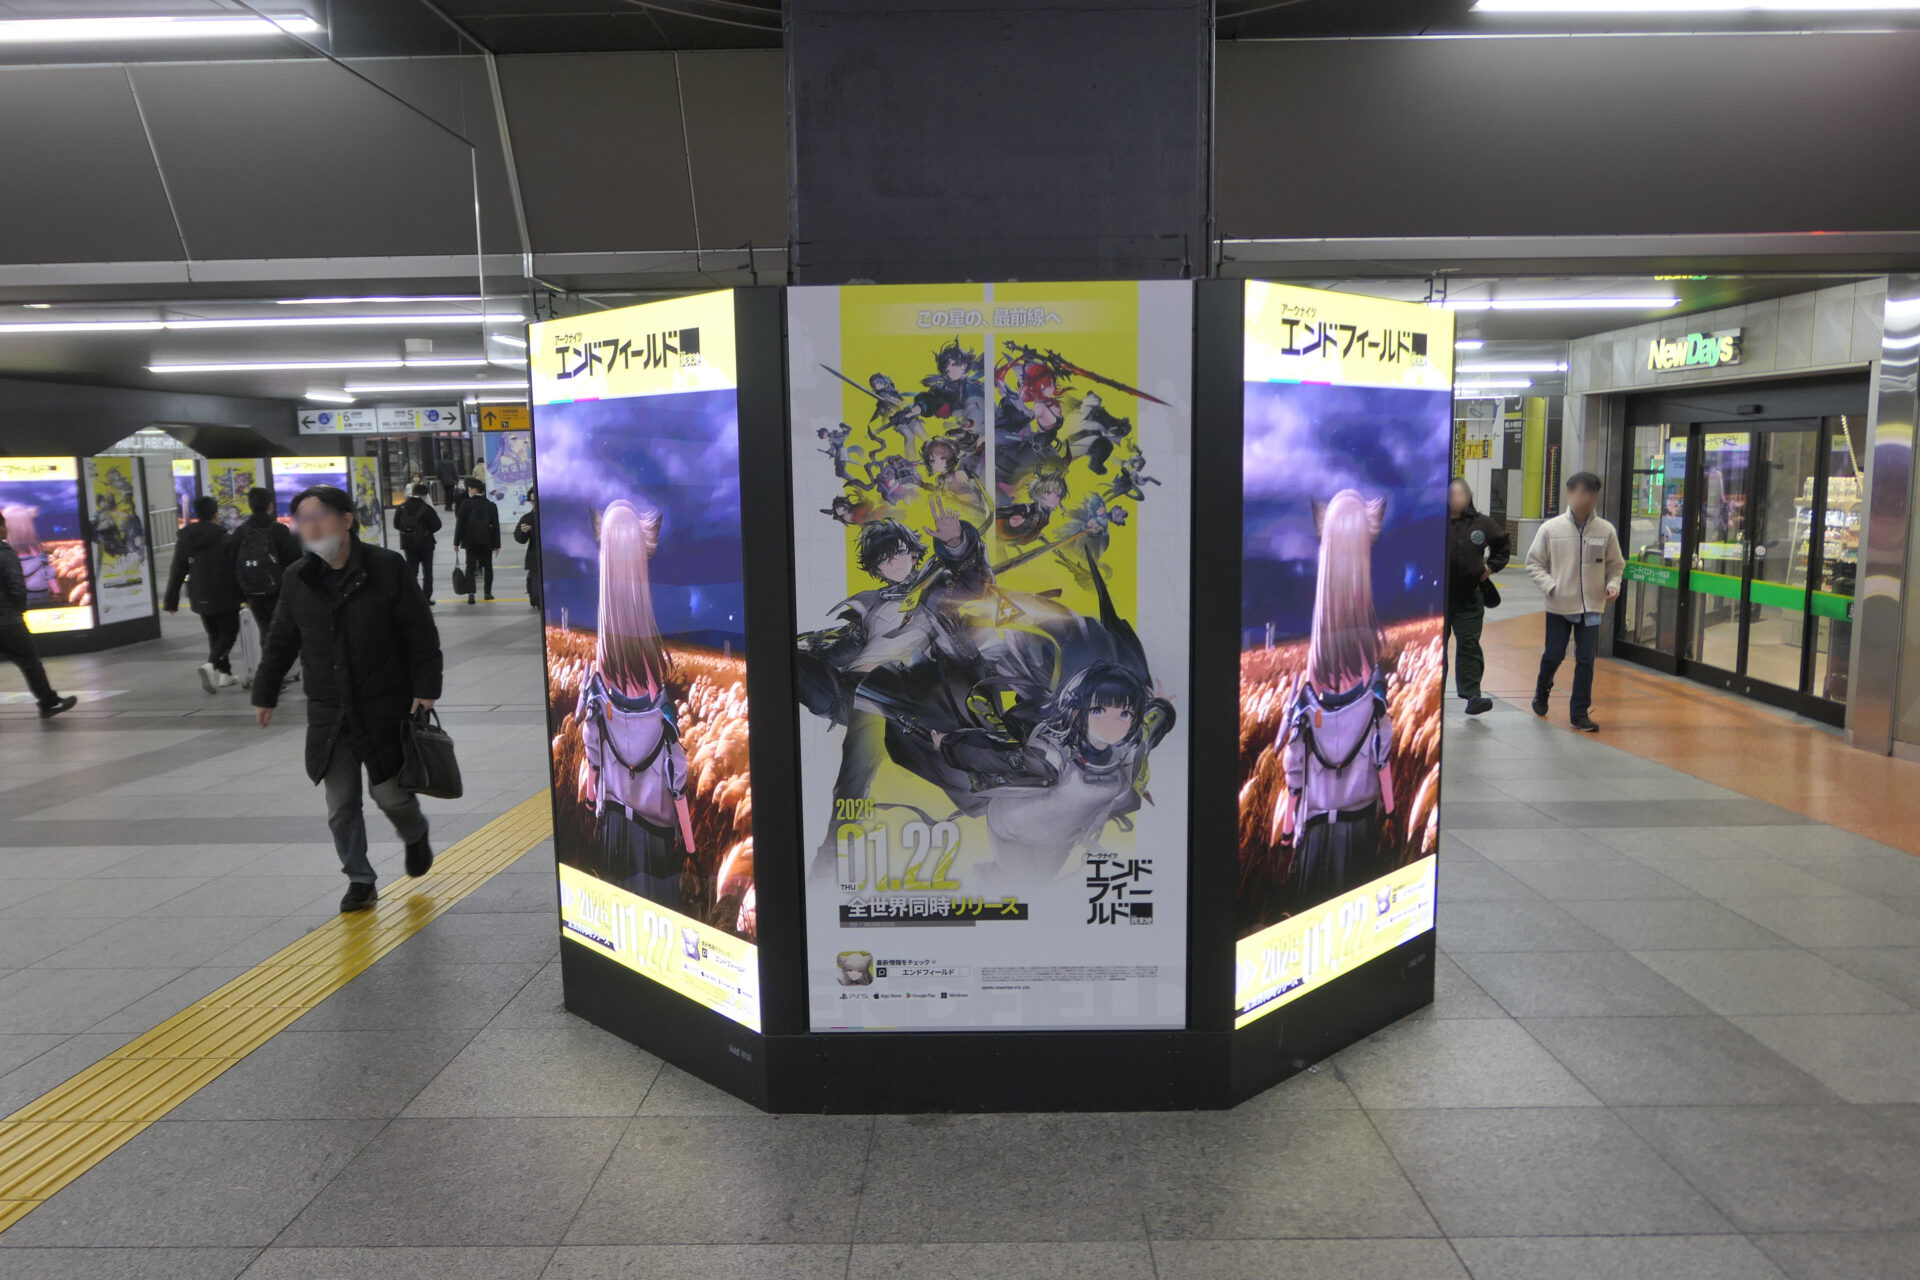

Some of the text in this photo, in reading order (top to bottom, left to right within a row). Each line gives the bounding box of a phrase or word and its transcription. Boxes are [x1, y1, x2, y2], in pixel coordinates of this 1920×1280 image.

[917, 308, 1061, 328] この星の、最前線へ
[554, 332, 582, 346] アークナイツ
[1281, 318, 1411, 364] エンドフィールド
[555, 330, 679, 380] エンドフィールド
[1648, 333, 1734, 370] NewDays
[343, 411, 350, 422] 6
[407, 409, 414, 420] 5
[836, 798, 873, 820] 2026
[837, 821, 961, 891] 01.22
[1086, 859, 1153, 882] エンド
[1086, 882, 1153, 904] フィー
[848, 897, 1020, 918] 全世界同時リリース
[1086, 903, 1129, 925] ルド
[902, 968, 955, 976] エンドフィールド
